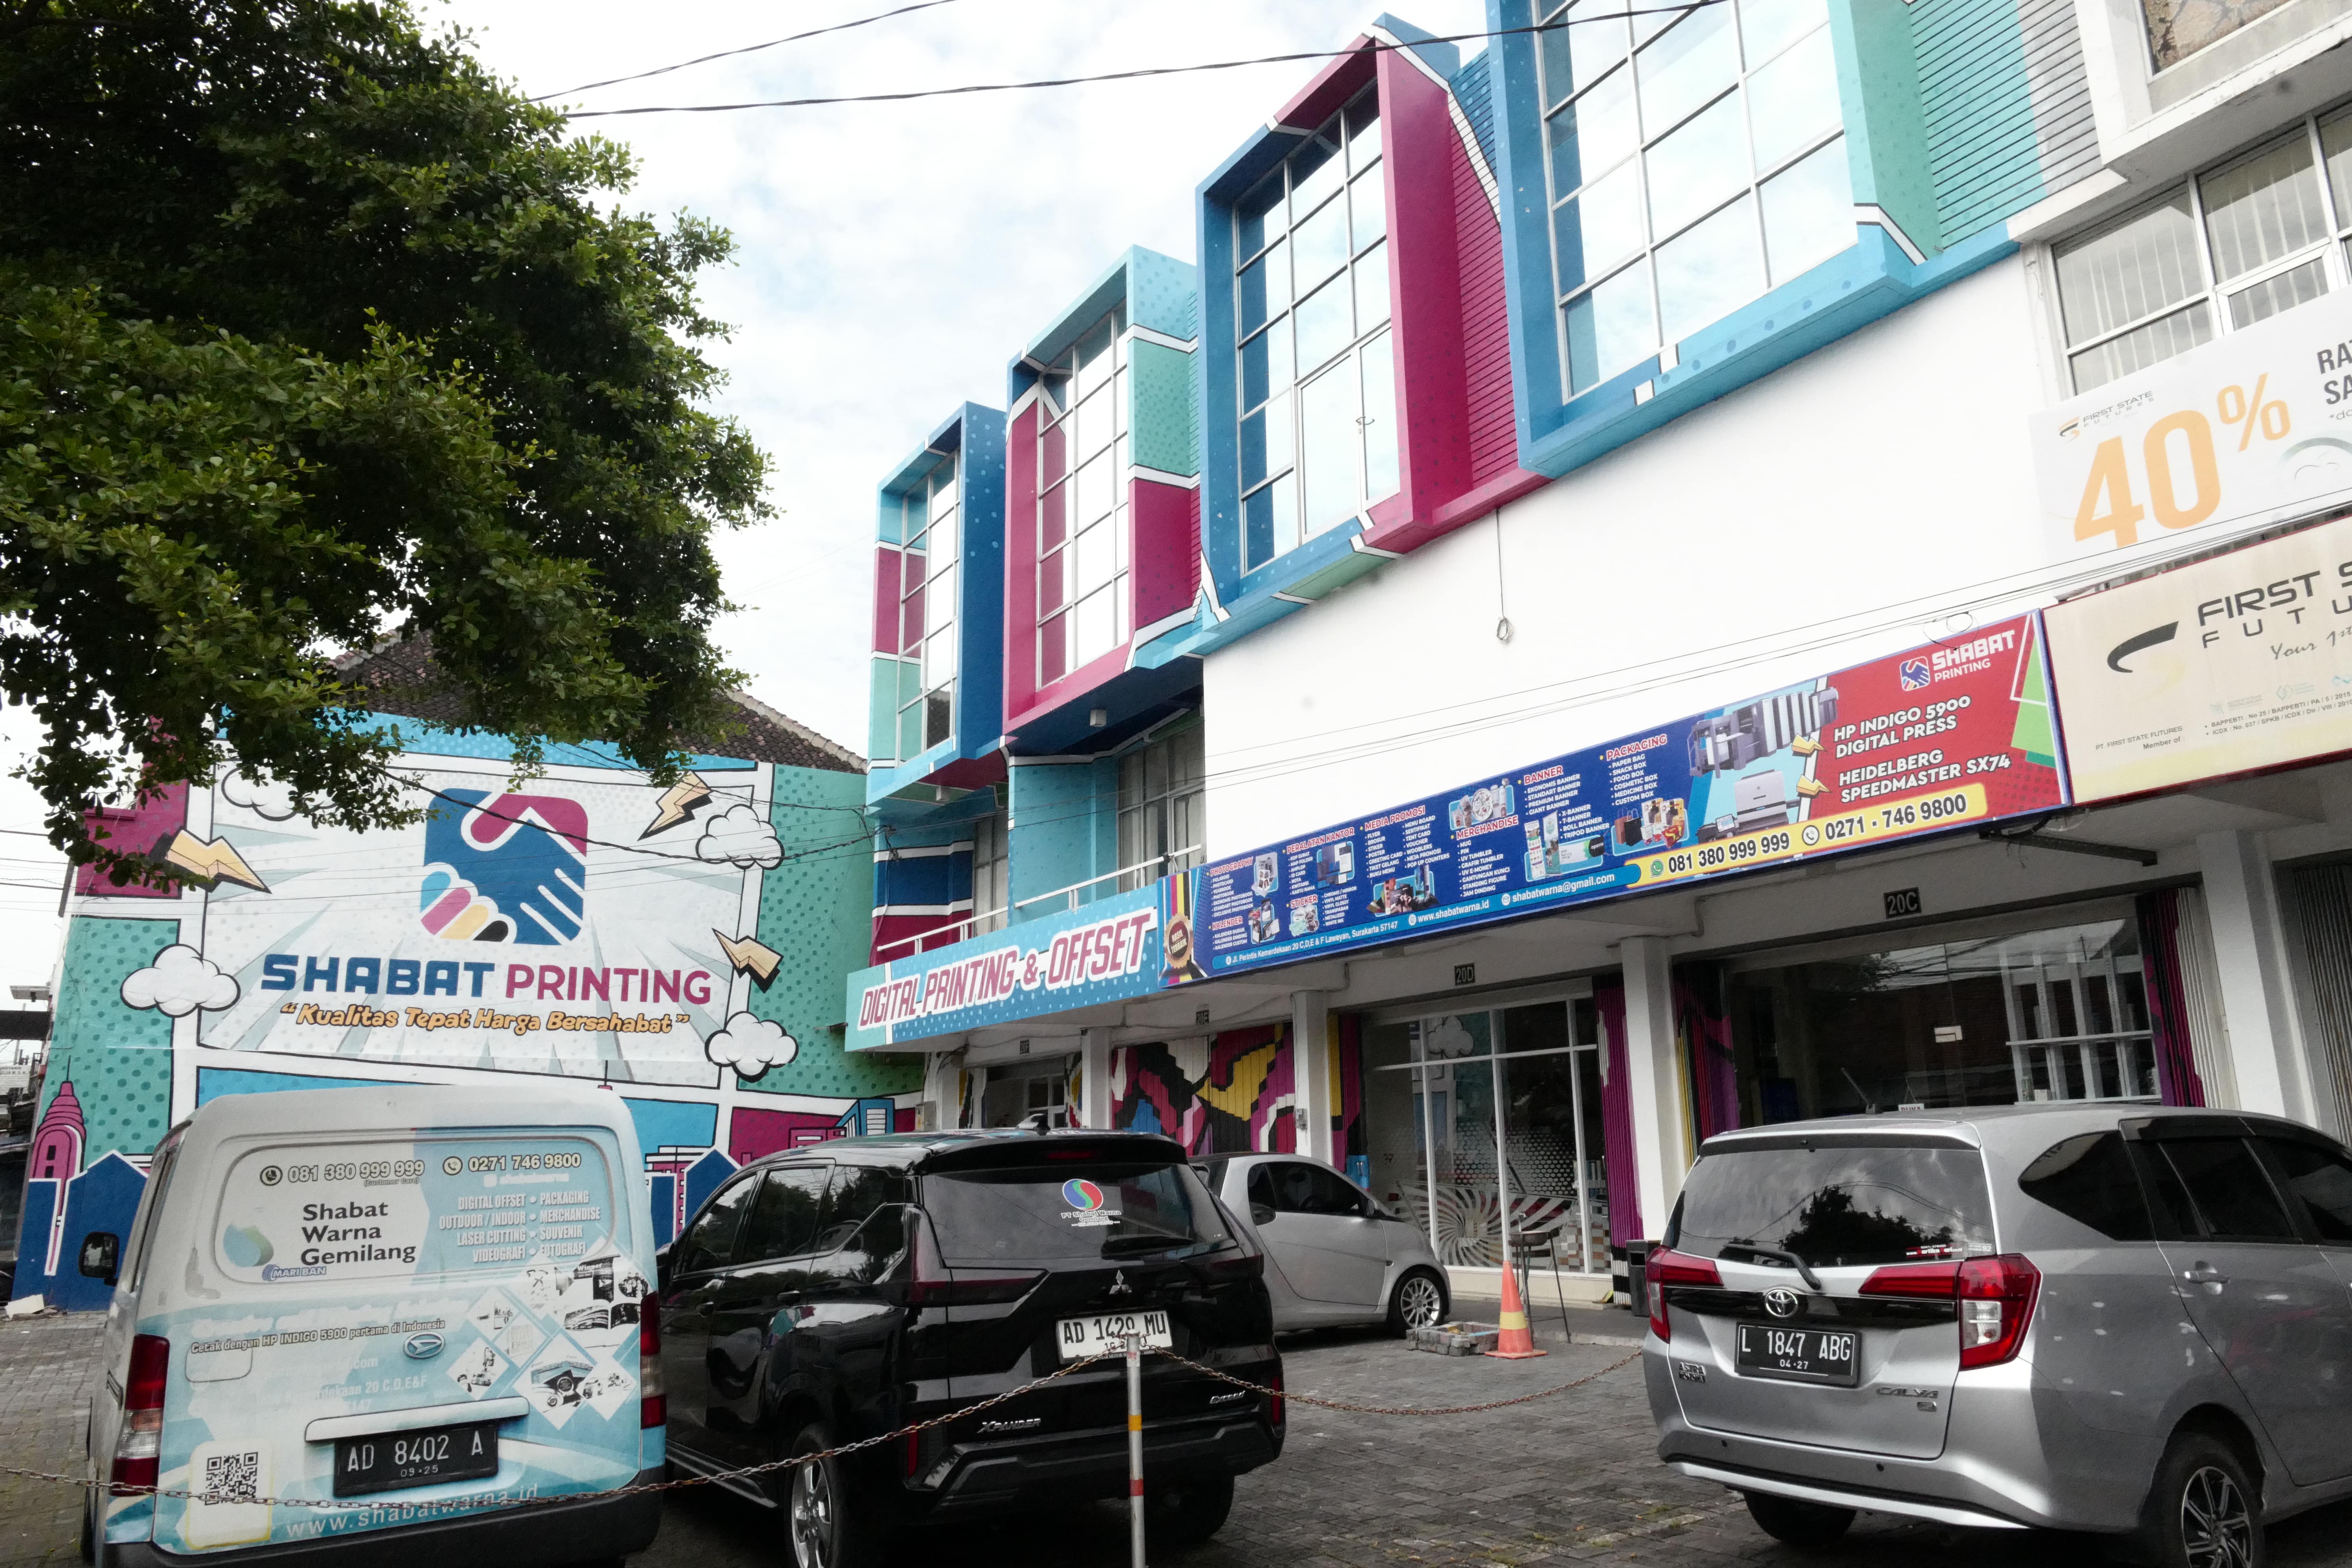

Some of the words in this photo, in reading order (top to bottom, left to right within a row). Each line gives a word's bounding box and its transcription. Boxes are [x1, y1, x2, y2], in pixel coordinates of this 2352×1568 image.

[2317, 339, 2352, 374] RA
[2083, 406, 2114, 422] FIRST
[2117, 390, 2153, 409] STATE
[2084, 397, 2154, 428] FUTURES
[2074, 372, 2291, 548] 40%
[2198, 570, 2321, 626] FIRST
[1932, 630, 2015, 671] SHABAT
[2270, 642, 2317, 660] Your
[1934, 658, 1991, 682] PRINTING
[2335, 691, 2351, 700] 2015
[1834, 724, 1857, 742] HP
[1860, 707, 1921, 735] INDIGO
[1926, 695, 1971, 719] 5900
[1606, 734, 1667, 761] PACKAGING
[1836, 731, 1899, 759] DIGITAL
[1904, 715, 1957, 741] PRESS
[2107, 739, 2126, 748] FIRST
[2127, 733, 2149, 743] STATE
[2150, 726, 2183, 738] FUTURES
[2143, 739, 2172, 750] Member
[1524, 765, 1564, 786] BANNER
[1839, 749, 1943, 786] HEIDELBERG
[1841, 763, 1961, 803] SPEEDMASTER
[1966, 754, 2011, 774] SX74
[1527, 780, 1556, 793] EKONOMIS
[1557, 774, 1580, 785] BANNER
[1528, 788, 1556, 801] STANDART
[1557, 781, 1581, 792] BANNER
[1614, 778, 1644, 790] COSMETIC
[1615, 786, 1643, 798] MEDICINE
[1644, 782, 1658, 790] BOX
[1365, 816, 1390, 831] MEDIA
[1390, 805, 1425, 824] PROMOSI
[1456, 815, 1519, 840] MERCHANDISE
[1563, 823, 1578, 831] ROLL
[1579, 817, 1602, 827] BANNER
[1287, 835, 1325, 854] PERALATAN
[1326, 827, 1355, 842] KANTOR
[1368, 836, 1385, 845] BROSUR
[1563, 829, 1585, 839] TRIPOD
[1586, 823, 1610, 833] BANNER
[1668, 853, 1693, 873] 081
[1698, 846, 1725, 867] 380
[1729, 840, 1756, 861] 999
[1761, 832, 1789, 854] 999
[1825, 816, 1865, 840] 0271
[1882, 805, 1915, 828] 746
[1920, 794, 1967, 820] 9800
[1406, 838, 1428, 848] VOUCHER
[1210, 857, 1254, 877] PHOTOGRAPHY
[1461, 860, 1479, 869] GRAFIR
[1480, 854, 1503, 864] TUMBLER
[1512, 874, 1615, 902] shabatwarna@gmail.com
[1290, 894, 1318, 909] STICKER
[1325, 906, 1348, 915] TRANSPARAN
[1418, 899, 1489, 923] www.shabatwarna.id
[1887, 891, 1917, 914] 20C
[1212, 916, 1243, 931] KALENDER
[1240, 952, 1257, 961] Perintis
[1258, 945, 1291, 957] Kemerdekaan
[1325, 933, 1350, 943] Laweyan,
[1352, 926, 1379, 937] Surakarta
[1380, 921, 1398, 931] 57147
[261, 954, 495, 997] SHABAT
[506, 964, 711, 1005] PRINTING
[860, 978, 918, 1027] DIGITAL
[922, 950, 1018, 1013] PRINTING
[1024, 953, 1038, 985] &
[1048, 913, 1151, 984] OFFSET
[1456, 967, 1474, 983] 20D
[405, 1007, 470, 1031] Tepat
[473, 1008, 541, 1036] Harga
[288, 1165, 319, 1183] 081
[324, 1163, 356, 1181] 380
[359, 1161, 390, 1179] 999
[394, 1159, 425, 1176] 999
[468, 1156, 506, 1172] 0271
[512, 1154, 541, 1169] 746
[544, 1153, 581, 1169] 9800
[303, 1201, 388, 1221] Shabat
[458, 1196, 493, 1210] DIGITAL
[495, 1193, 526, 1208] OFFSET
[540, 1191, 589, 1205] PACKAGING
[439, 1214, 483, 1230] OUTDOOR
[492, 1211, 526, 1226] INDOOR
[540, 1207, 600, 1223] MERCHANDISE
[301, 1225, 382, 1243] Warna
[457, 1231, 485, 1246] LASER
[487, 1229, 526, 1244] CUTTING
[540, 1225, 583, 1240] SOUVENIR
[301, 1244, 416, 1266] Gemilang
[474, 1246, 525, 1263] VIDEOGRAFI
[272, 1267, 300, 1278] MARI
[301, 1266, 326, 1276] BAN
[577, 1262, 603, 1271] Winner
[191, 1339, 223, 1353] Cetak
[223, 1337, 259, 1351] dengan
[262, 1334, 278, 1347] HP
[280, 1332, 318, 1345] INDIGO
[320, 1328, 347, 1341] 5900
[349, 1326, 389, 1340] pertama
[392, 1322, 400, 1333] di
[403, 1318, 445, 1332] Indonesia
[1063, 1322, 1085, 1344] AD
[1144, 1313, 1167, 1335] MU
[1742, 1328, 1751, 1352] L
[1768, 1330, 1805, 1357] 1847
[1818, 1335, 1851, 1361] ABG
[1679, 1362, 1705, 1375] ASTRA
[1679, 1372, 1705, 1383] TOYOTA
[1877, 1387, 1938, 1398] CALYA
[348, 1444, 374, 1472] AD
[394, 1435, 449, 1465] 8402
[472, 1430, 483, 1455] A
